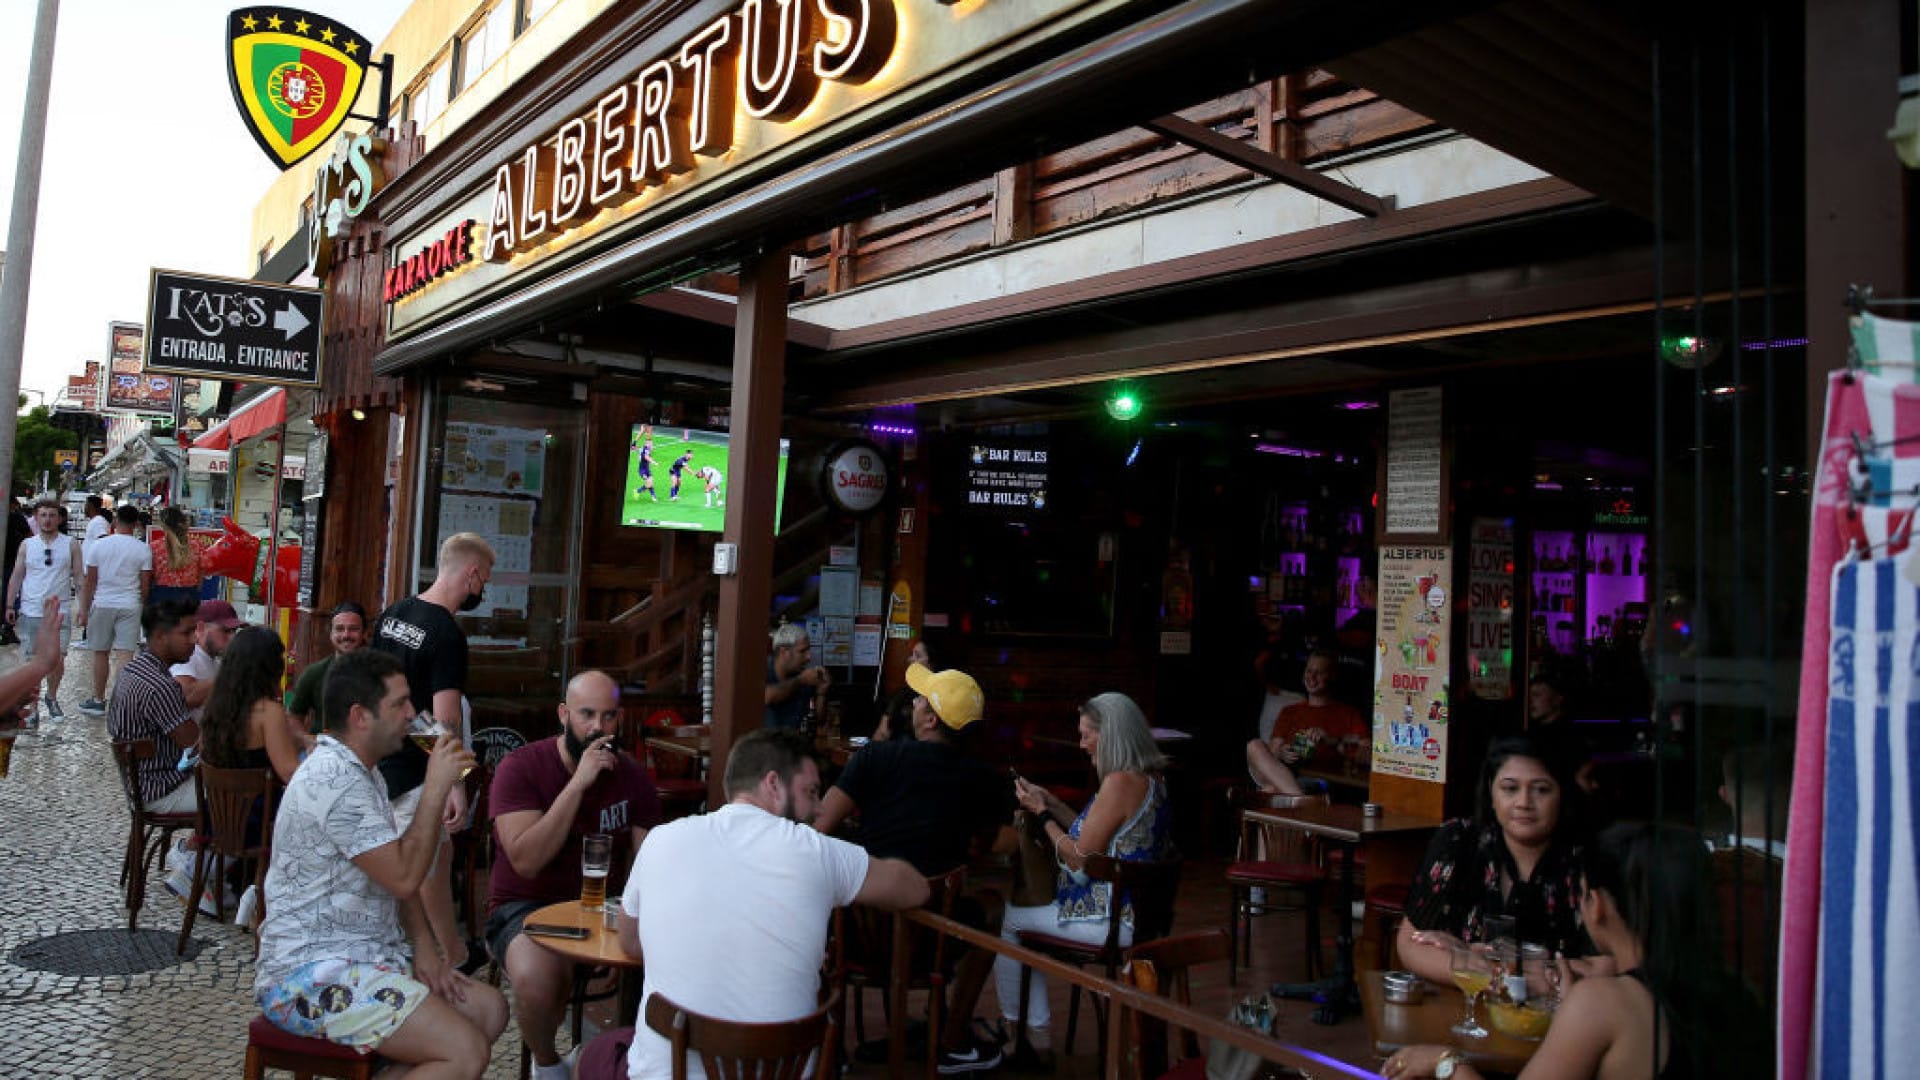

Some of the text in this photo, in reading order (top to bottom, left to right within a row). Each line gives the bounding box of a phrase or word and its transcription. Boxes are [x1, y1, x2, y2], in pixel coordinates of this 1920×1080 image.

[384, 219, 469, 303] KARAOKE
[160, 337, 226, 363] ENTRADA
[237, 345, 310, 371] ENTRANCE
[989, 449, 1047, 462] BAR RULES
[838, 470, 885, 489] SAGRES
[968, 490, 1029, 505] BAR RULES
[1383, 549, 1446, 560] ALBERTUS
[1471, 546, 1514, 572] LOVE
[1469, 622, 1511, 649] LIVE
[1392, 673, 1430, 691] BOAT
[599, 799, 630, 834] ART
